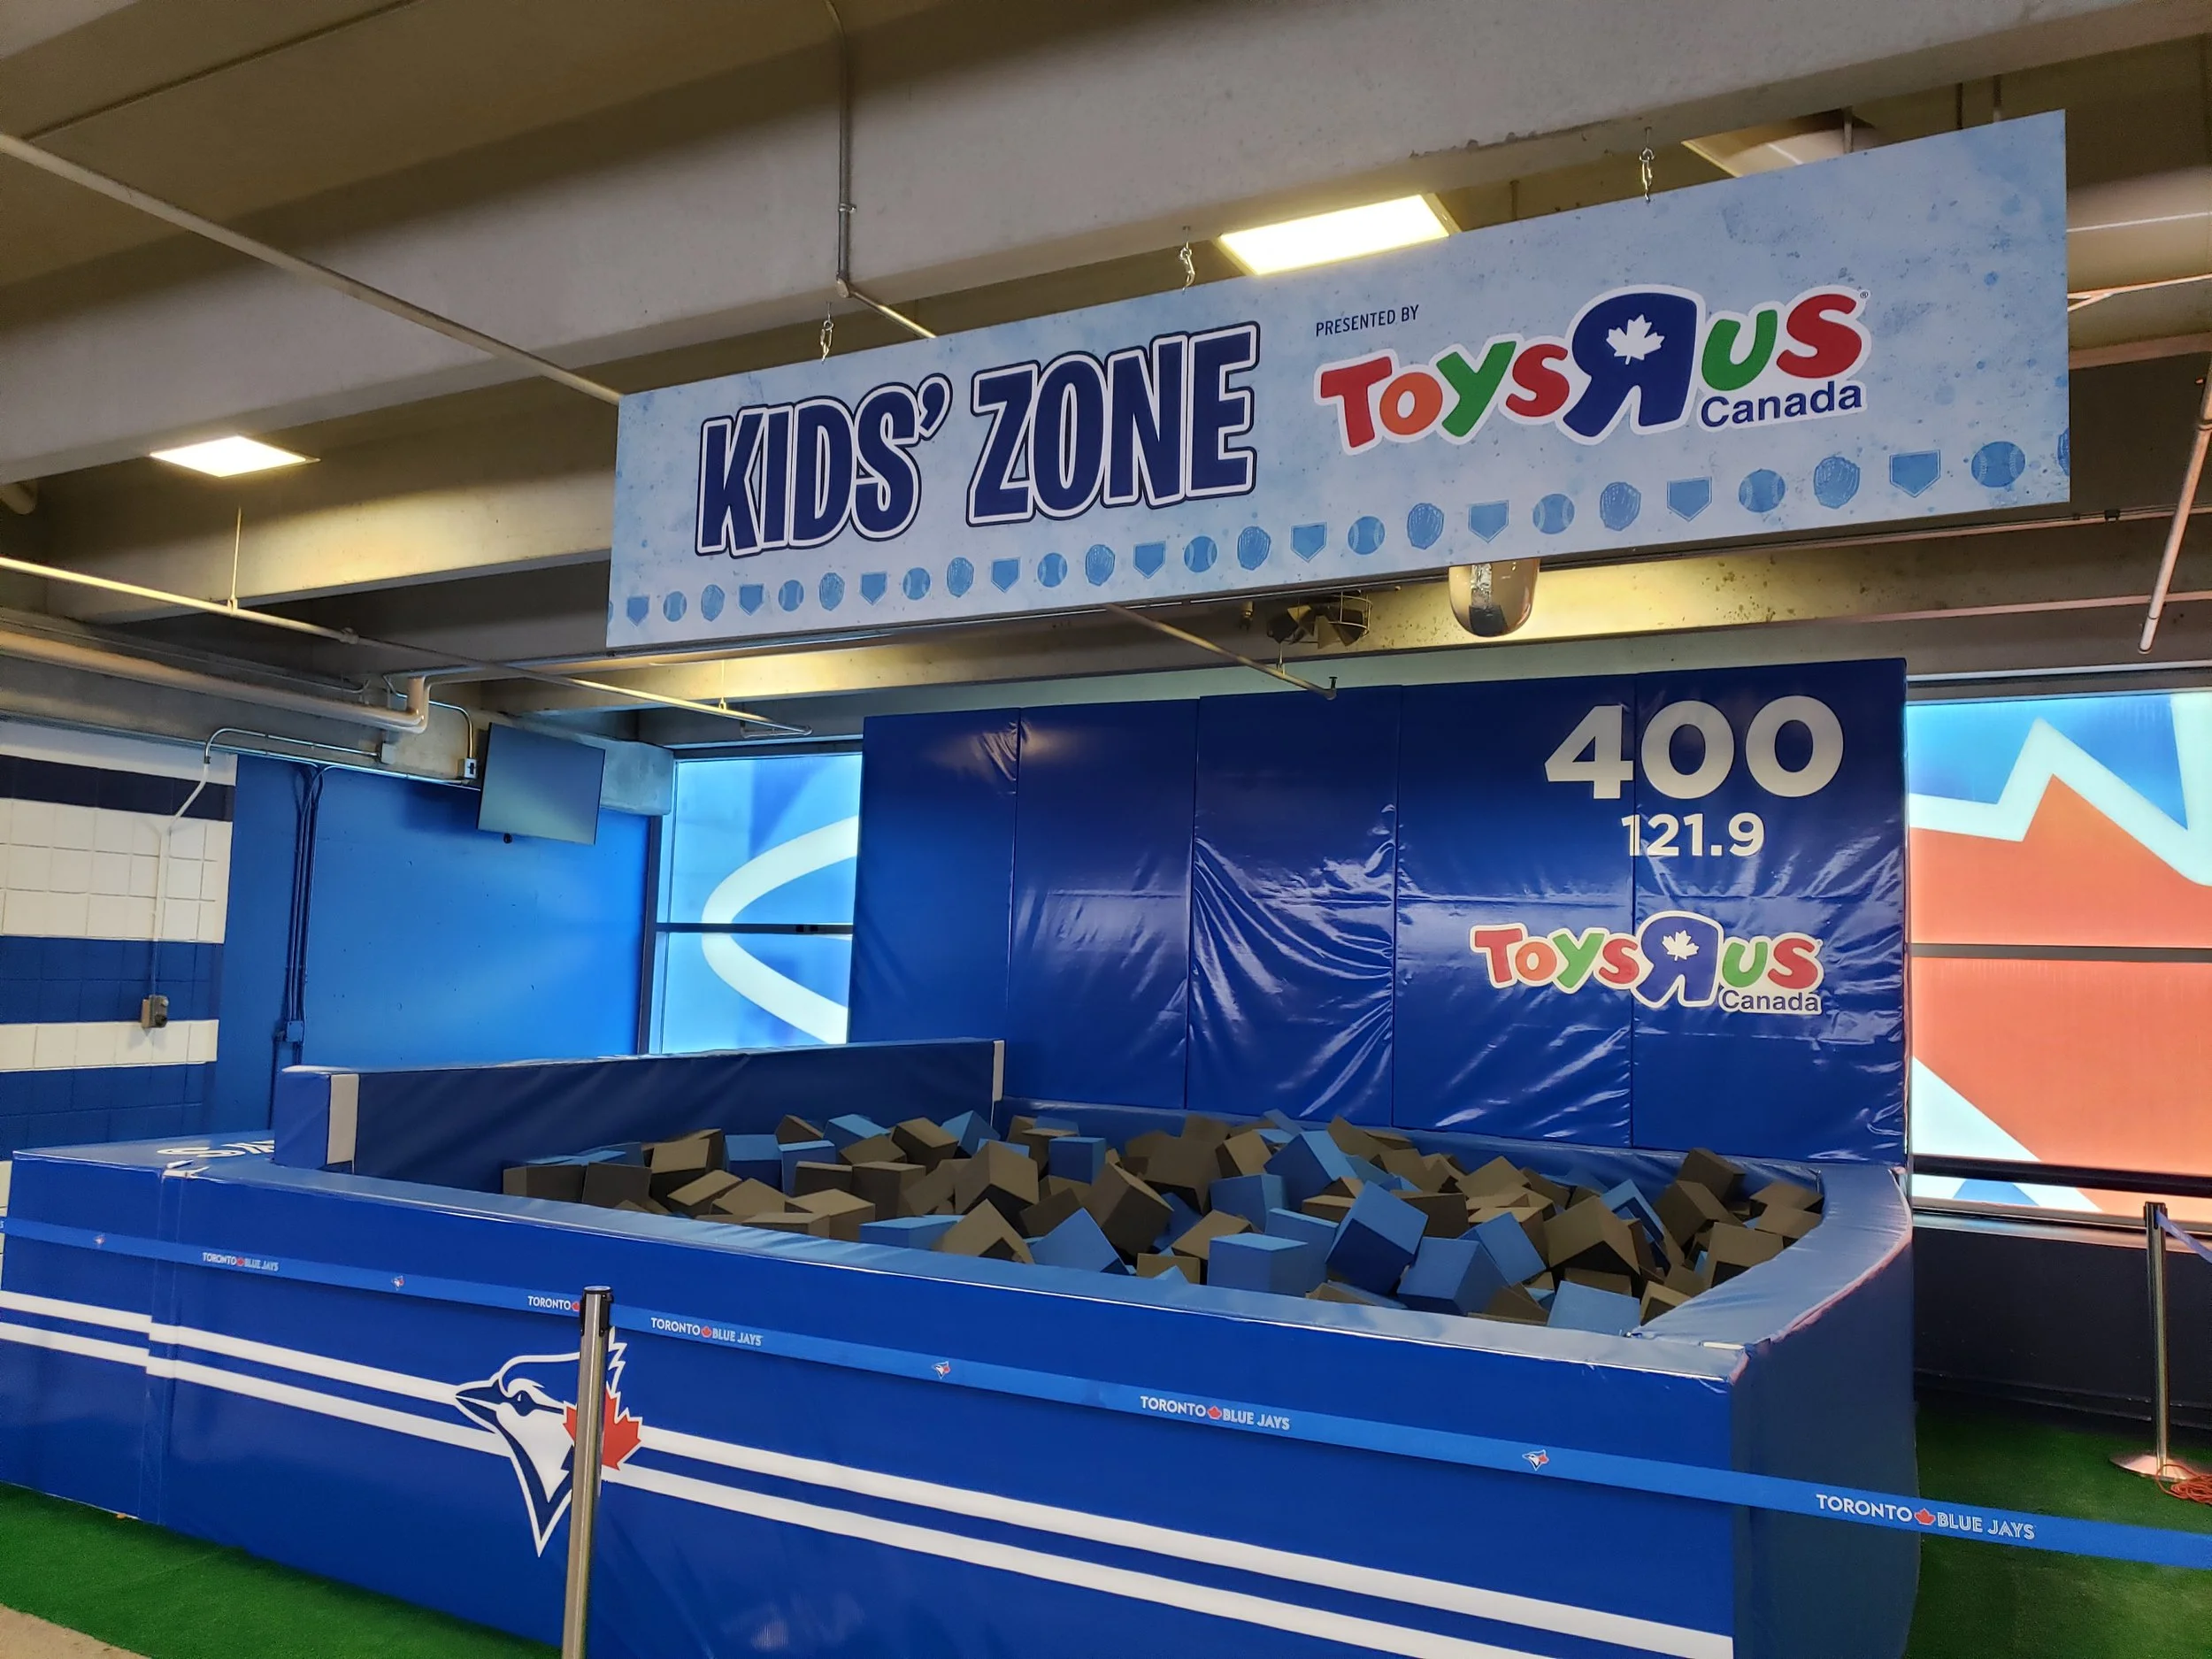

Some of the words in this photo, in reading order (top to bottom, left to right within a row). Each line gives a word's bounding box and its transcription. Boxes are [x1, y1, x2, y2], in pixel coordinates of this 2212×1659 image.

[1316, 310, 1396, 336] PRESENTED
[1401, 304, 1419, 322] BY
[1701, 380, 1863, 427] Canada
[695, 373, 953, 558] KIDS'
[966, 320, 1260, 526] ZONE
[1544, 695, 1844, 799] 400
[1621, 812, 1765, 856] 121.9
[1721, 990, 1820, 1012] Canada
[203, 1252, 236, 1264] TORONTO
[244, 1258, 261, 1269] BLUE
[527, 1295, 571, 1310] TORONTO
[650, 1317, 701, 1336] TORONTO
[712, 1328, 736, 1342] BLUE
[737, 1332, 763, 1347] JAYS
[1141, 1395, 1206, 1417] TORONTO
[1223, 1408, 1255, 1425] BLUE
[1256, 1414, 1290, 1430] JAYS
[1816, 1494, 1913, 1522] TORONTO
[1937, 1511, 1983, 1532] BLUE
[1987, 1519, 2036, 1540] JAYS
